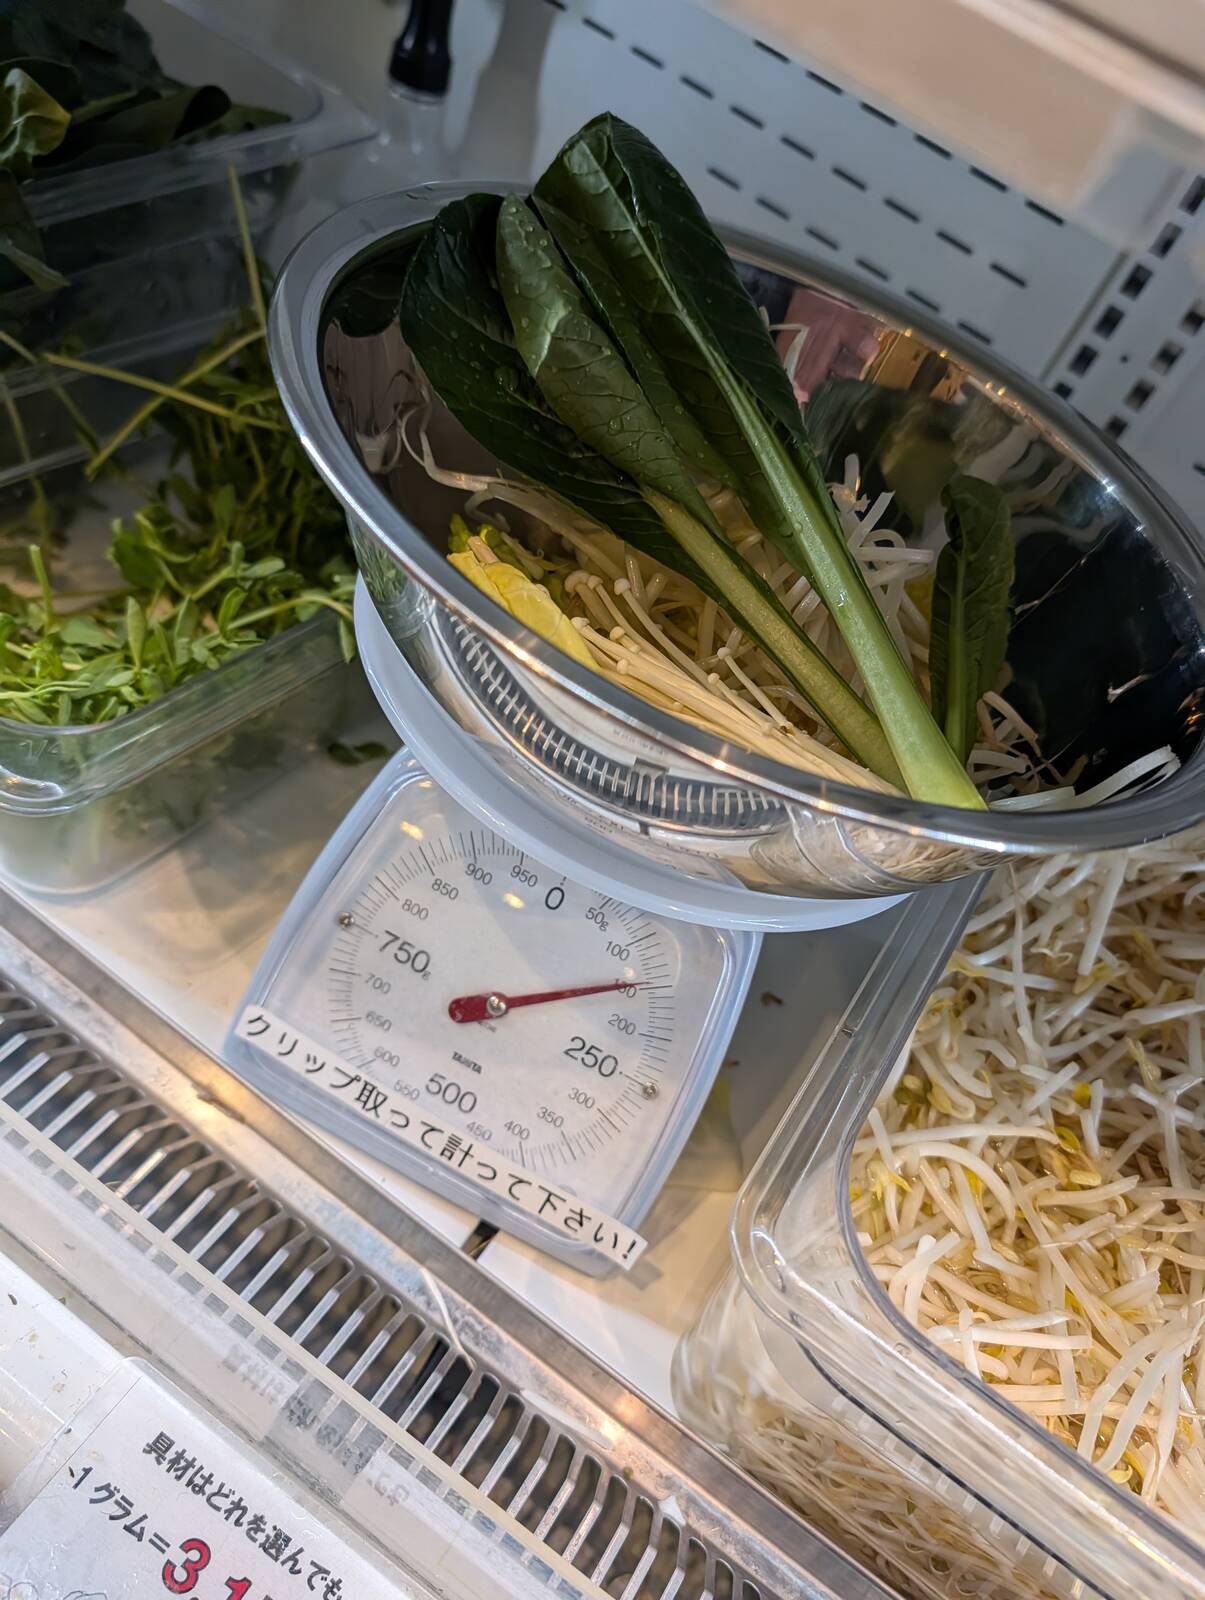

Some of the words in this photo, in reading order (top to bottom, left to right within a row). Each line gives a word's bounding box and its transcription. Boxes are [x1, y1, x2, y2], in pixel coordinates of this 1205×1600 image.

[465, 863, 493, 886] 900
[510, 865, 538, 888] 950
[432, 878, 459, 900] 850
[545, 886, 565, 910] 0
[402, 898, 429, 920] 800
[605, 940, 630, 961] 100
[364, 972, 392, 995] 700
[366, 1010, 392, 1032] 650
[607, 1013, 636, 1035] 200
[374, 1046, 400, 1067] 600
[563, 1036, 619, 1079] 250
[393, 1079, 420, 1101] 550
[425, 1072, 477, 1114] 500
[568, 1086, 595, 1109] 300
[536, 1106, 564, 1129] 350
[247, 1013, 638, 1260] クリップ取って計って下さい!
[466, 1121, 493, 1141] 450
[503, 1120, 531, 1141] 400
